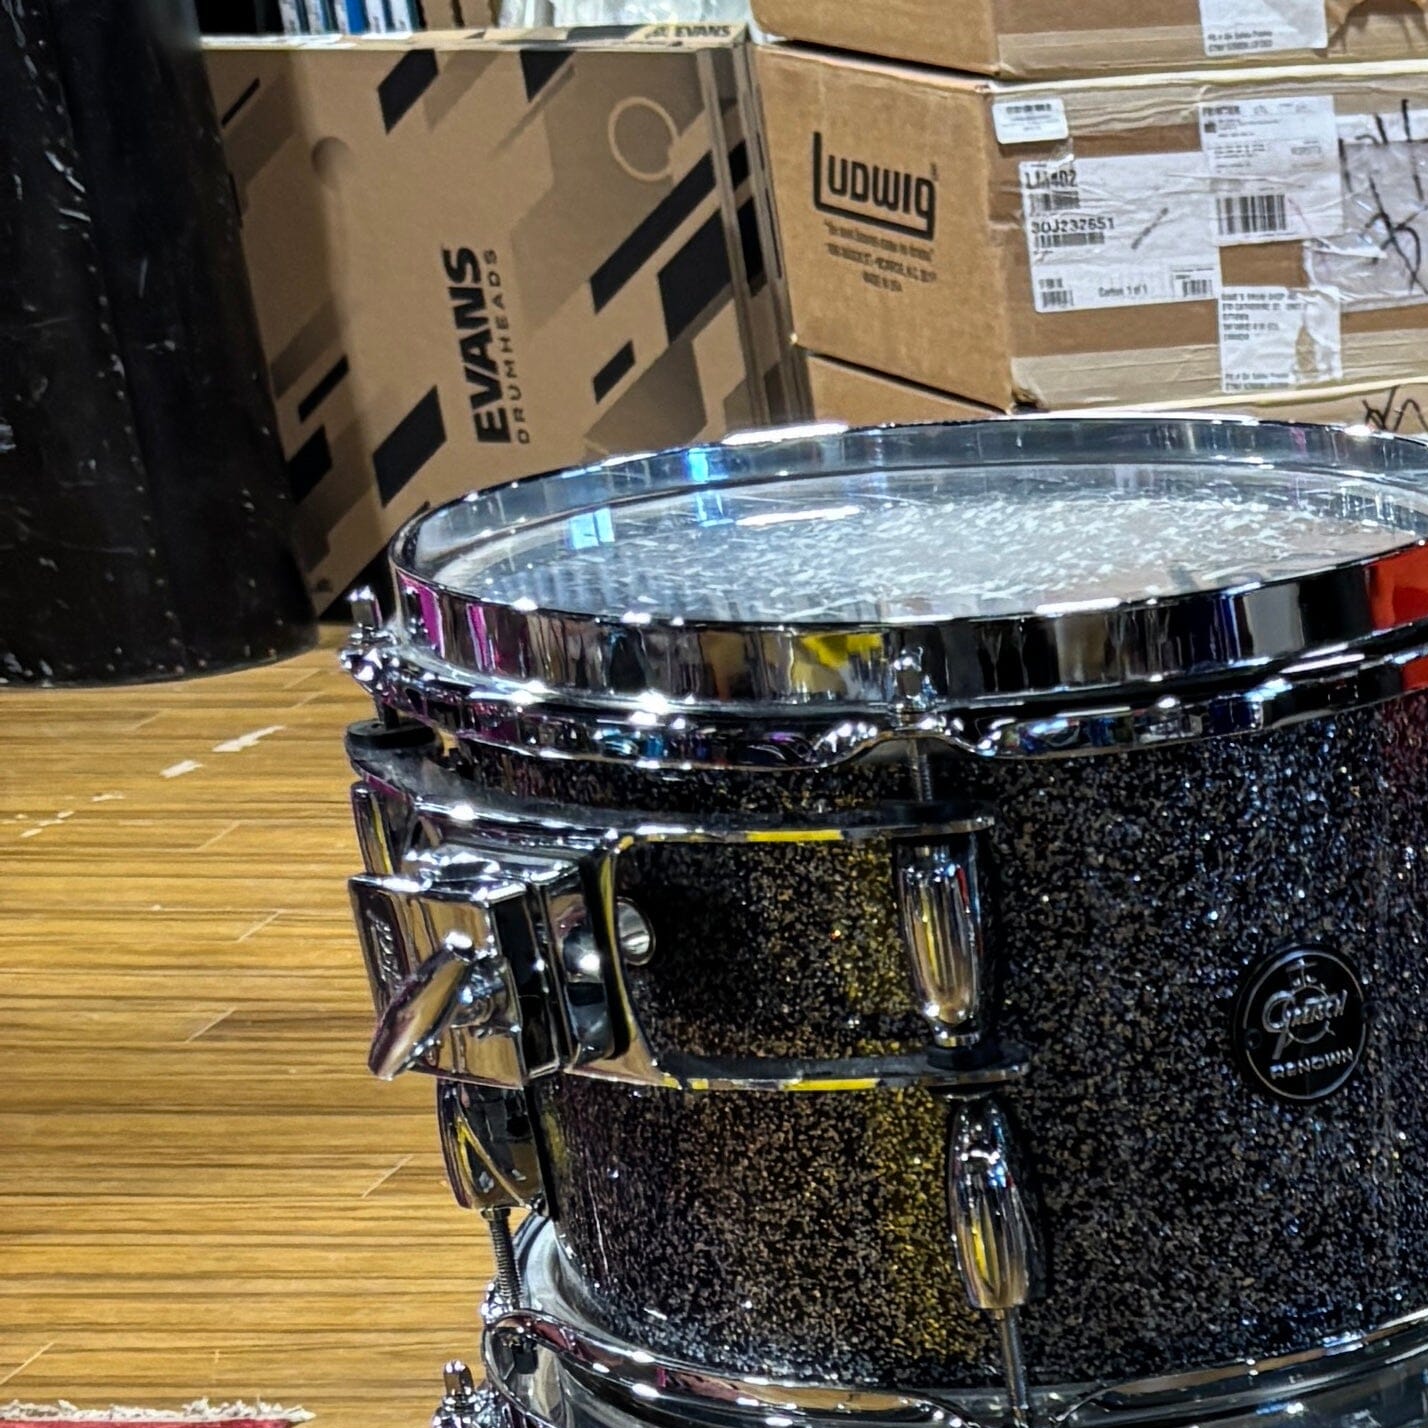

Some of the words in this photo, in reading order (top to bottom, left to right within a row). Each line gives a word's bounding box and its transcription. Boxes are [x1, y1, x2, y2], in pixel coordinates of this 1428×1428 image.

[674, 24, 731, 37] EVANS
[440, 243, 513, 446] EVANS
[482, 248, 530, 445] DRUMHEADS
[1269, 1046, 1354, 1080] RENOWN
